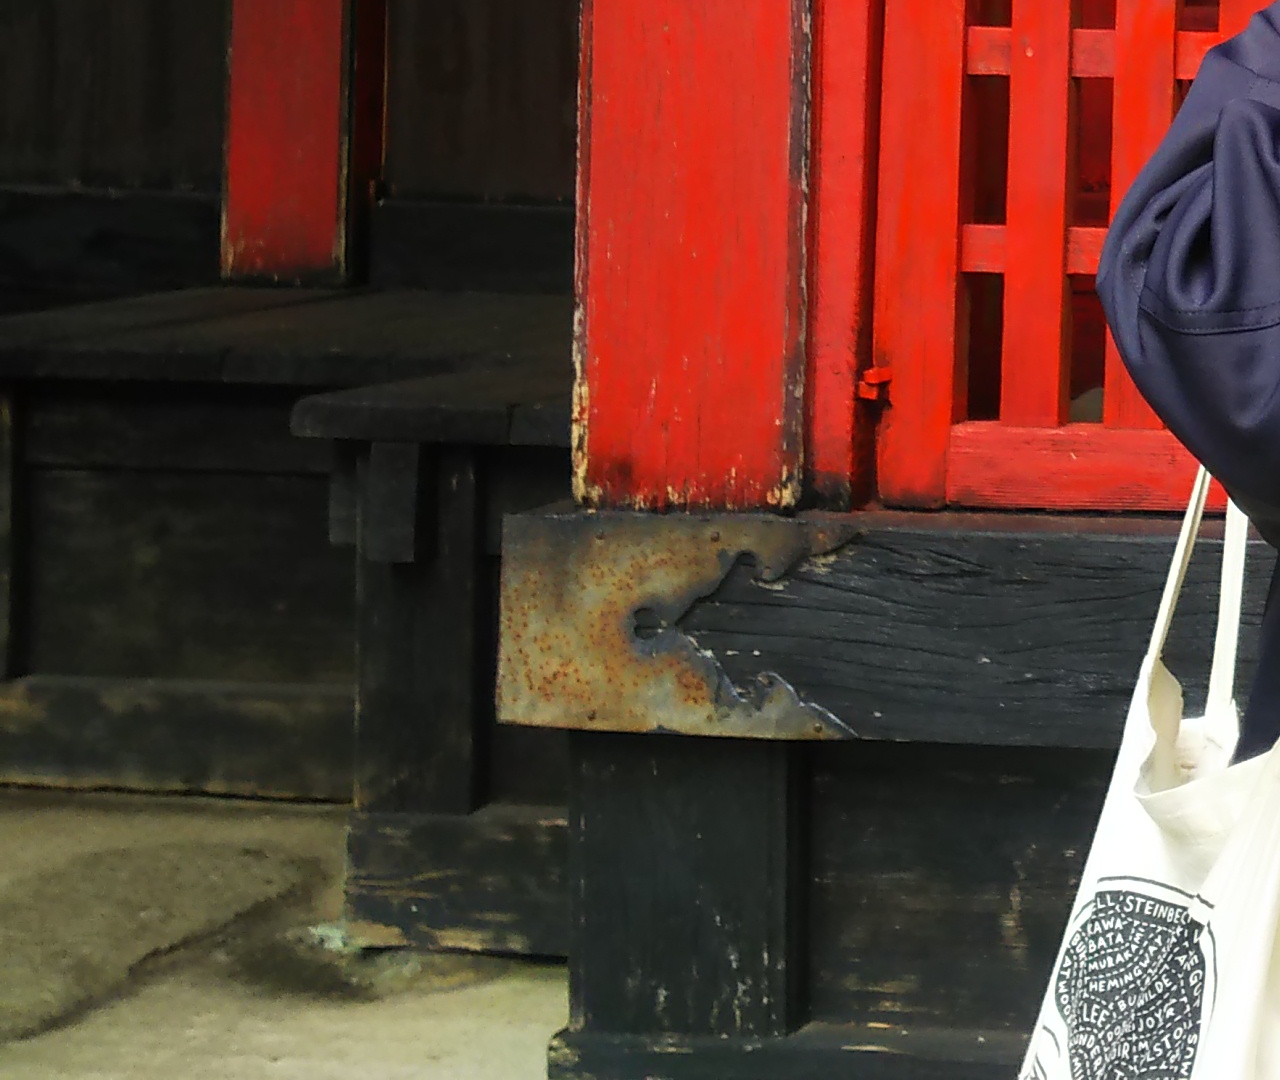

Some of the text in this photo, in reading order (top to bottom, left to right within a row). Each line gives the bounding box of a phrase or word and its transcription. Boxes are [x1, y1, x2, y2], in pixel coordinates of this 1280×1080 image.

[1088, 932, 1125, 953] BATA
[1089, 934, 1163, 992] HEMINGWAY
[1082, 1003, 1111, 1028] LEE
